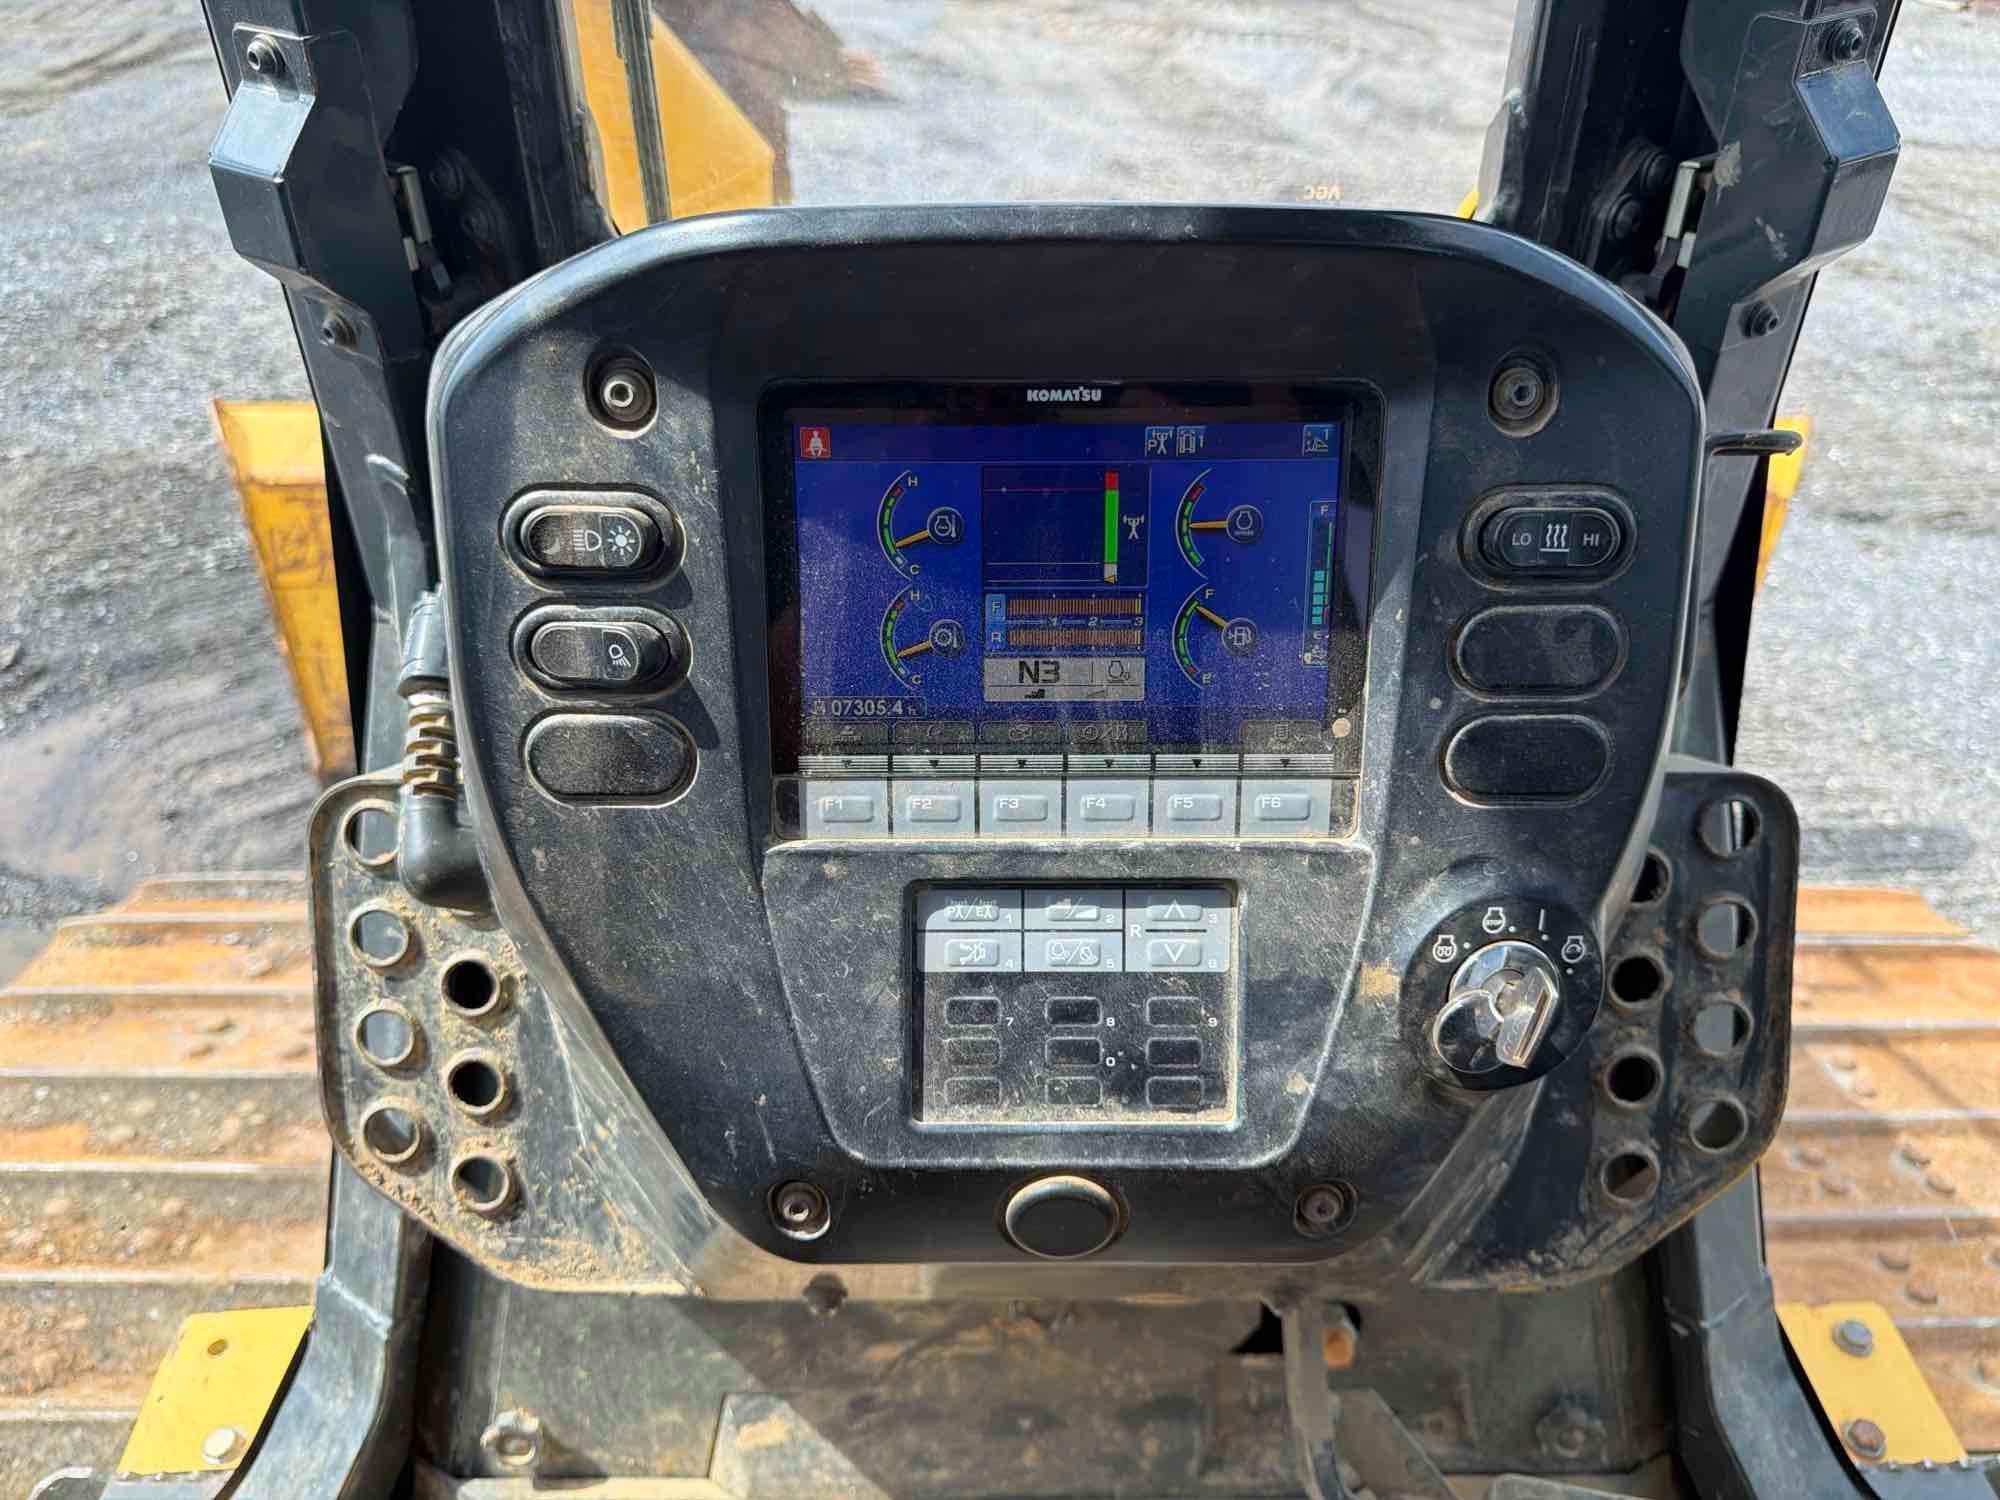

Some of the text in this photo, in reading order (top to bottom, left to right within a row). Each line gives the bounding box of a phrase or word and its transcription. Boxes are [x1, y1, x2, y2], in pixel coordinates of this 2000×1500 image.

[1026, 386, 1102, 402] KOMATSU
[907, 476, 918, 487] H
[1319, 504, 1329, 516] F
[1511, 532, 1532, 546] LO
[1583, 533, 1600, 546] HI
[909, 564, 920, 575] C
[909, 590, 920, 601] H
[1205, 588, 1216, 600] F
[1087, 616, 1098, 627] 2
[1133, 616, 1144, 627] 3
[1018, 660, 1061, 684] N3
[824, 799, 843, 810] F1
[911, 798, 933, 809] F2
[999, 798, 1018, 809] F3
[1085, 797, 1105, 808] F4
[1173, 797, 1193, 808] F5
[1260, 797, 1280, 808] F6
[1005, 914, 1012, 924] 1
[1105, 914, 1115, 924] 2
[1208, 913, 1217, 924] 3
[1130, 926, 1142, 938] R
[1005, 959, 1013, 969] 4
[1106, 959, 1115, 969] 5
[1006, 1017, 1014, 1027] 7
[1106, 1017, 1115, 1027] 8
[1208, 1017, 1217, 1027] 9
[1106, 1057, 1116, 1067] 0
